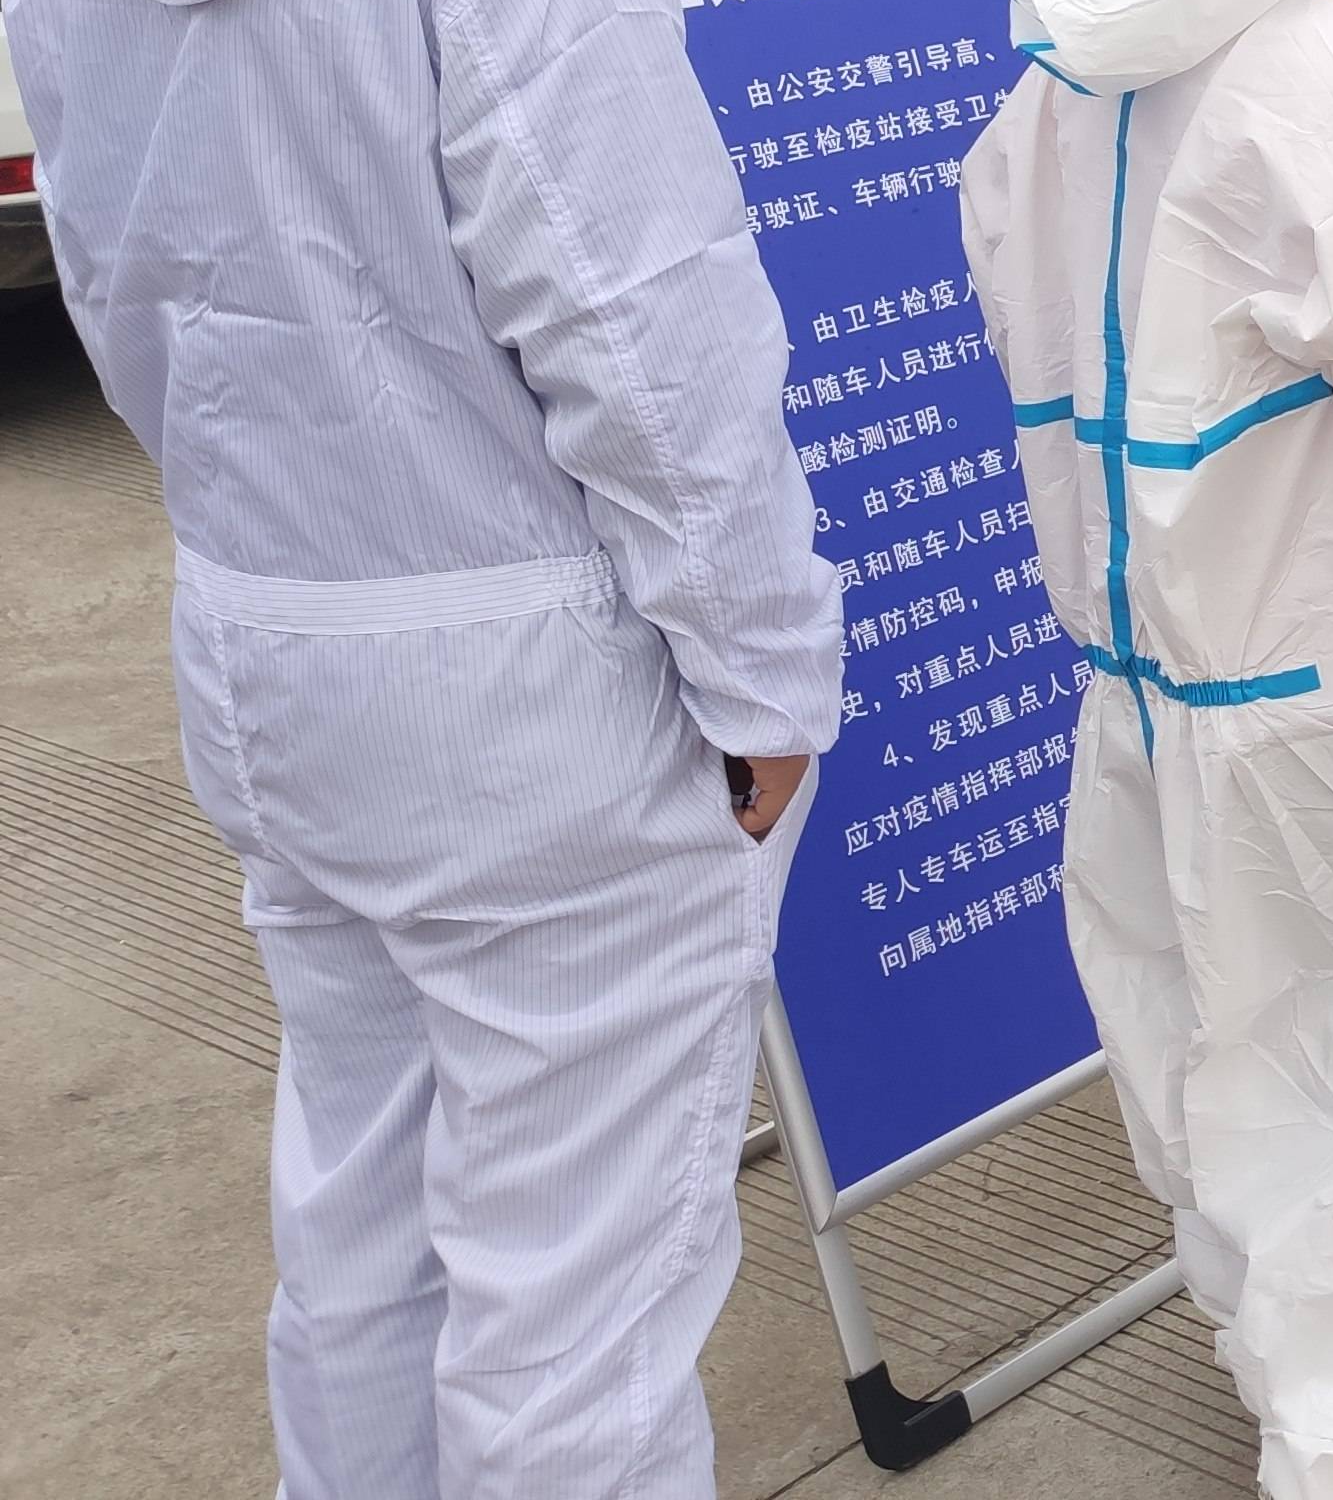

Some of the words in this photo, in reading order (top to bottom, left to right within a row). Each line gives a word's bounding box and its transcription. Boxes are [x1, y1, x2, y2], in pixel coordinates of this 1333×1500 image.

[798, 404, 958, 475] 酸检测证明。
[836, 500, 1034, 594] 员和随车人员扫
[838, 555, 1045, 660] 情防控码，申报
